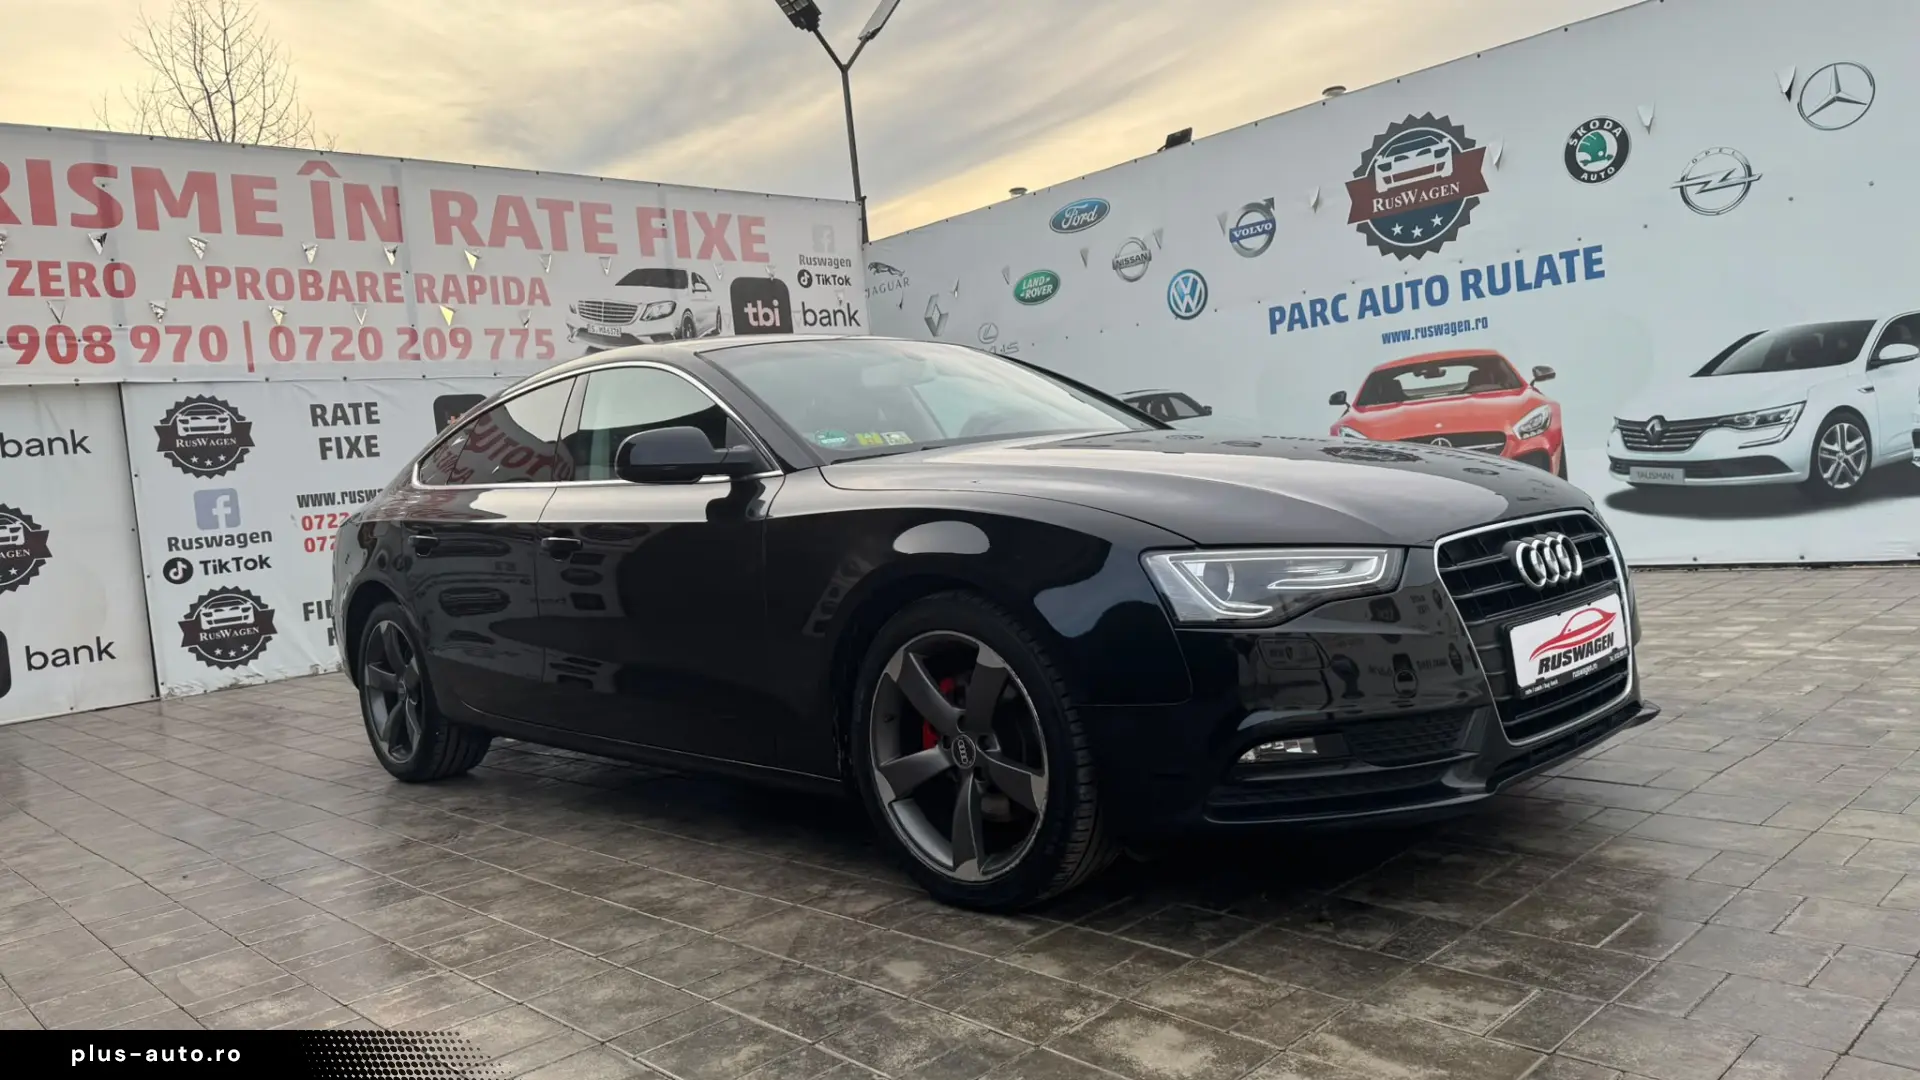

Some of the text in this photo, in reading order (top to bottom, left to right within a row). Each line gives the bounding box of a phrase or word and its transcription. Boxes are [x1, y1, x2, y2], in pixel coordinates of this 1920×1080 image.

[1580, 165, 1616, 181] AUTO
[297, 160, 404, 243] ÎN
[430, 189, 618, 255] RATE
[636, 206, 770, 263] FIXE
[1061, 203, 1098, 229] Ford
[1231, 222, 1273, 239] VOLVO
[799, 254, 852, 269] Ruswagen
[1115, 252, 1148, 267] NISSAN
[6, 259, 552, 307] ZERO APROBARE RAPIDA
[815, 273, 852, 287] TikTok
[864, 276, 910, 299] JAGUAR
[1268, 244, 1606, 335] PARC AUTO RULATE
[744, 299, 861, 327] tbi bank
[1381, 316, 1489, 345] www.ruswagen.ro
[6, 324, 116, 364] 908
[130, 324, 229, 364] 970
[268, 325, 384, 362] 0720
[396, 327, 473, 361] 209
[484, 328, 556, 361] 775
[310, 401, 381, 427] RATE
[319, 435, 381, 460] FIXE
[167, 530, 273, 552] Ruswagen
[199, 554, 272, 576] TikTok
[25, 636, 117, 671] bank
[1537, 632, 1615, 675] RUSWAGEN
